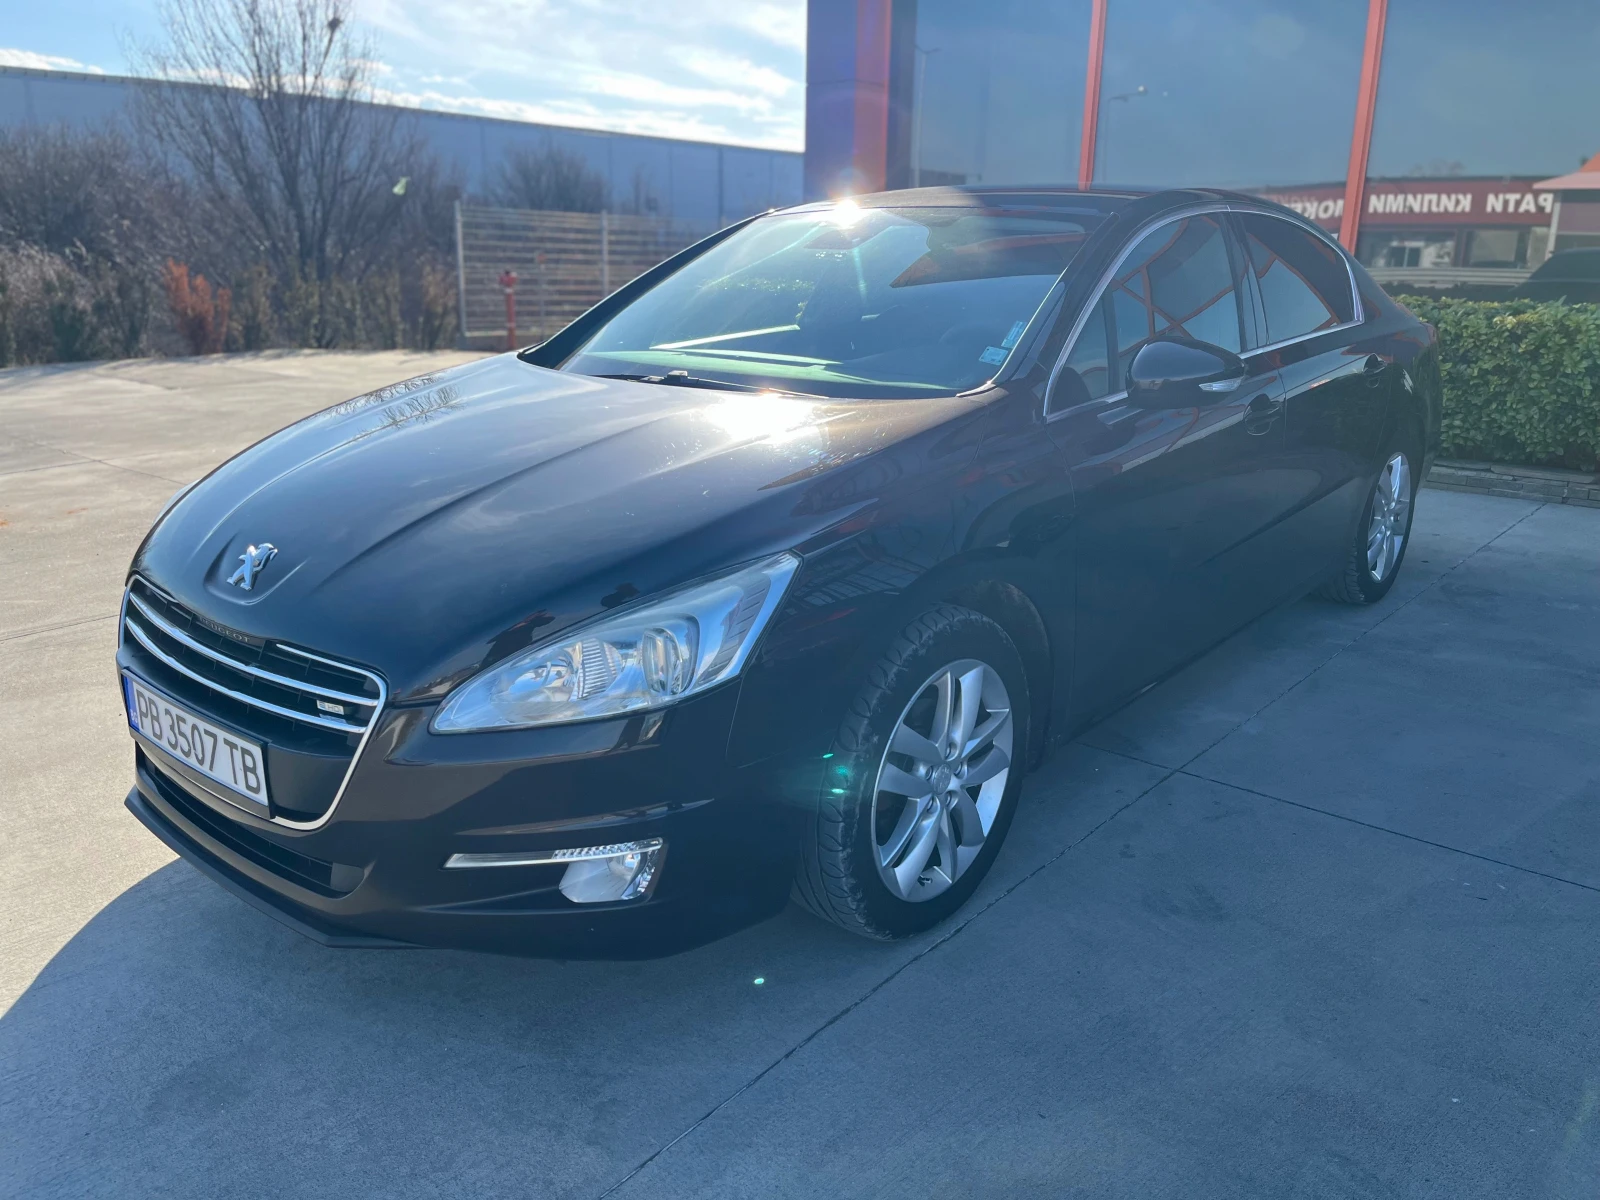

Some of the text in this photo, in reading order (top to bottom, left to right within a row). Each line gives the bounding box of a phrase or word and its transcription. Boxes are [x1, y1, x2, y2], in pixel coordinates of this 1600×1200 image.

[200, 616, 250, 643] PEUGEOT
[164, 707, 218, 772] 3507
[223, 737, 261, 795] TB
